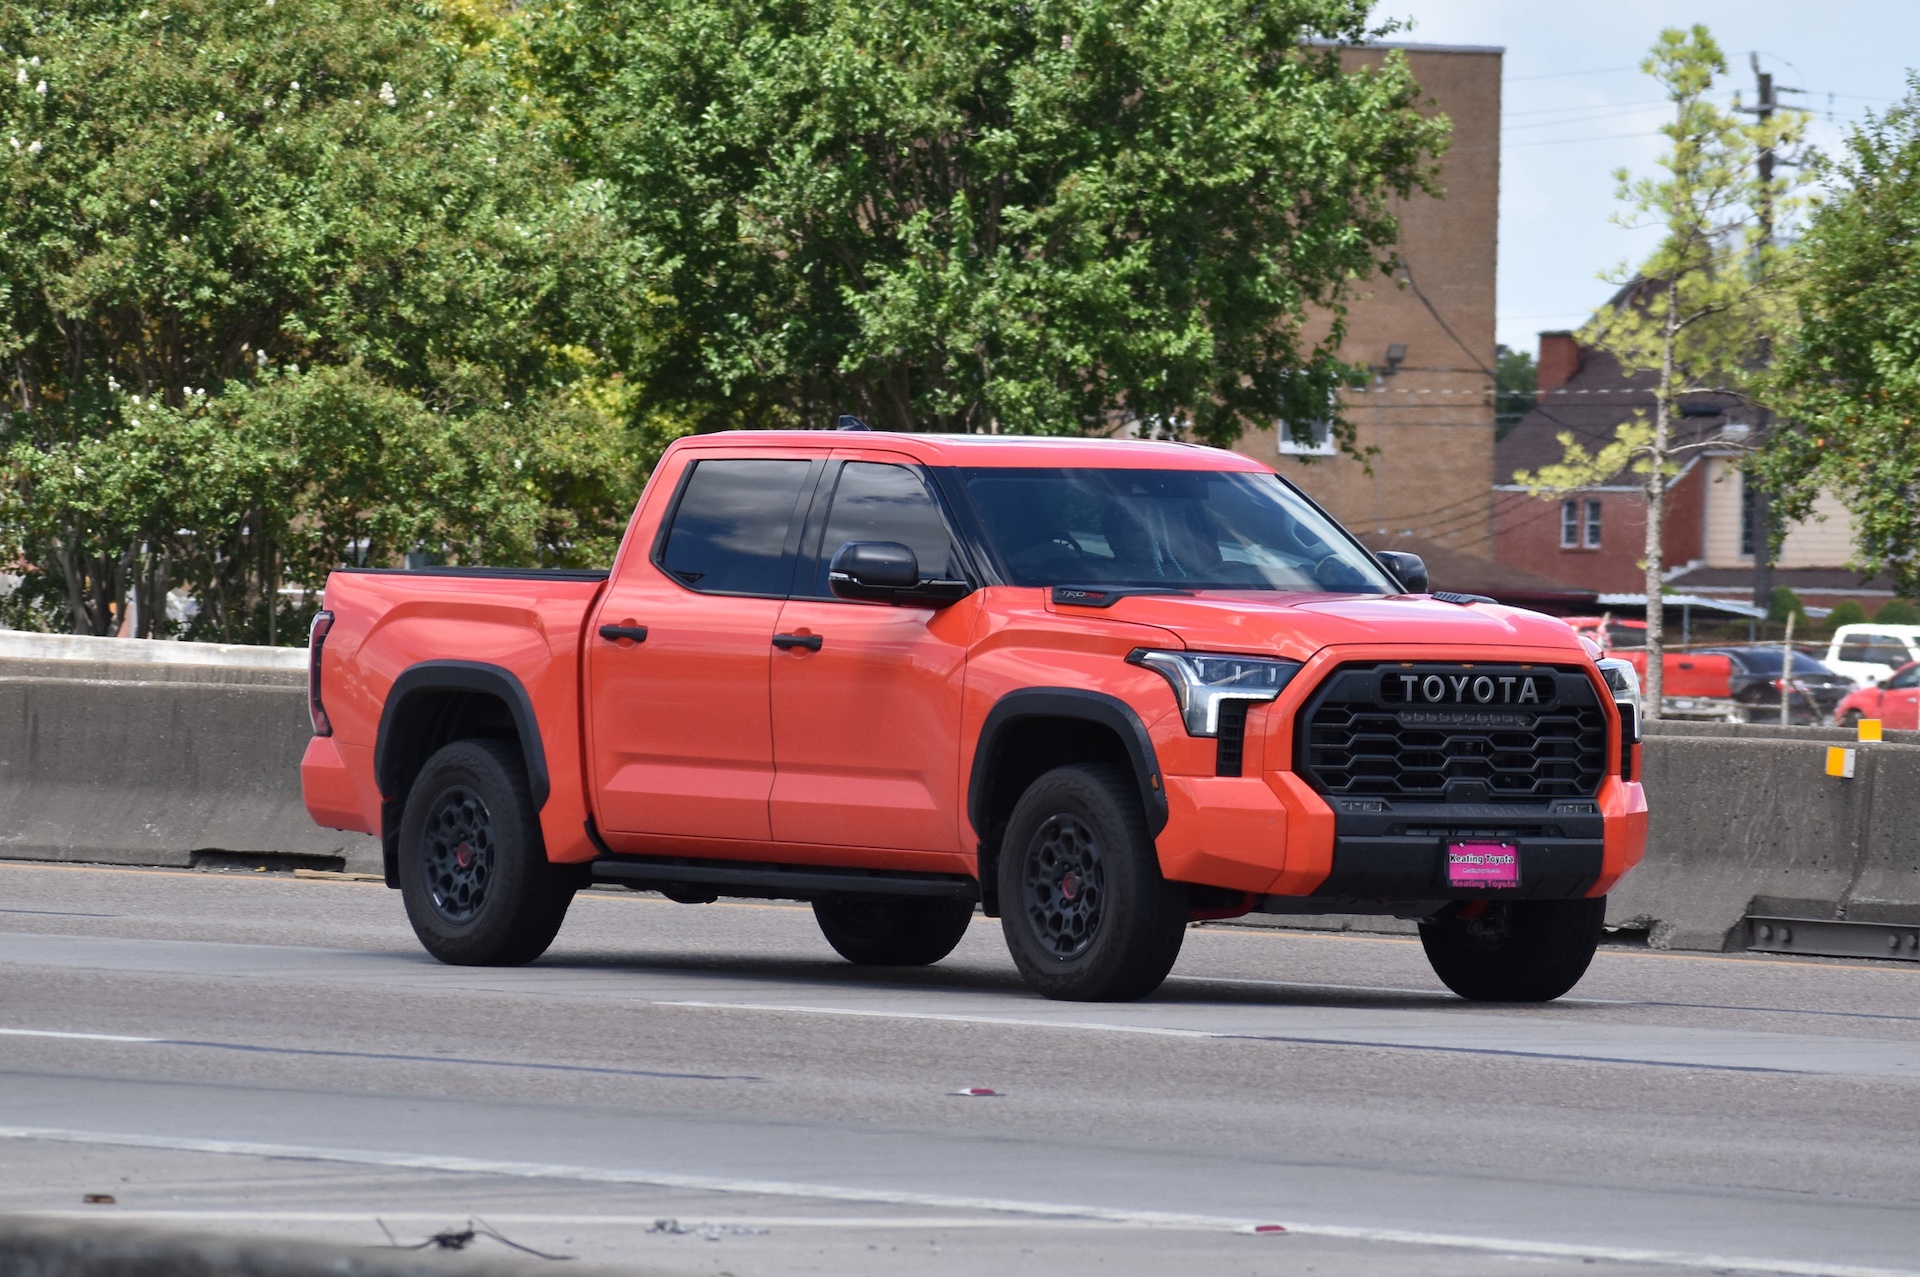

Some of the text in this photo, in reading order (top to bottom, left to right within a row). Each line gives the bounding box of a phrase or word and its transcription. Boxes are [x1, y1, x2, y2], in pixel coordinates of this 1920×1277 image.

[1061, 590, 1086, 598] TRD
[1400, 674, 1540, 704] TOYOTA
[1450, 853, 1514, 865] Keating Toyota
[1453, 880, 1516, 889] Keating Toyota
